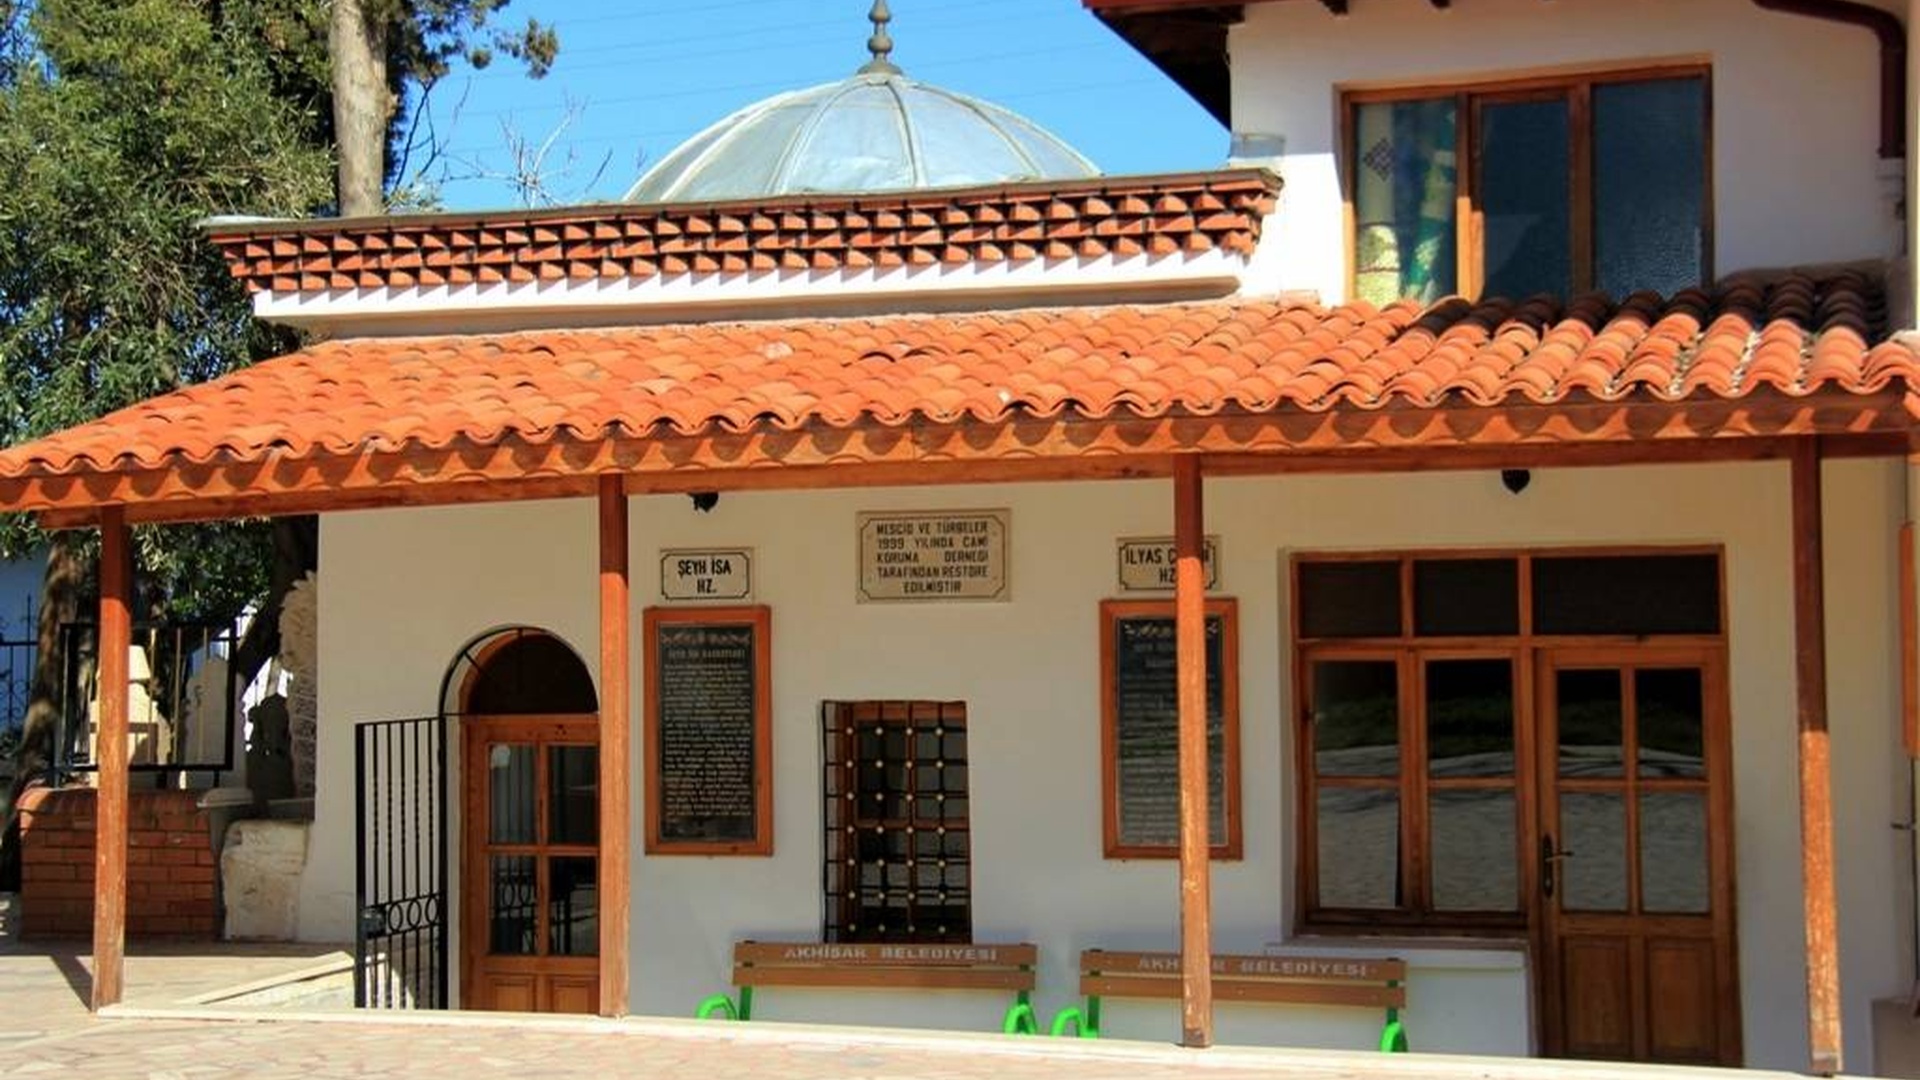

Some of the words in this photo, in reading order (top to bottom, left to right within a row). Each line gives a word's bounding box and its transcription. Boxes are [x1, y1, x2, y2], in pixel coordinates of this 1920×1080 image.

[918, 522, 930, 535] VE
[914, 537, 954, 549] YILINDA
[877, 551, 919, 564] KORUMA
[678, 559, 706, 579] ŞEYH
[711, 556, 732, 575] İSA
[877, 566, 939, 578] TARAFINDAN
[942, 565, 988, 578] RESTORE
[697, 578, 717, 594] HZ.
[1138, 957, 1226, 972] AKHR
